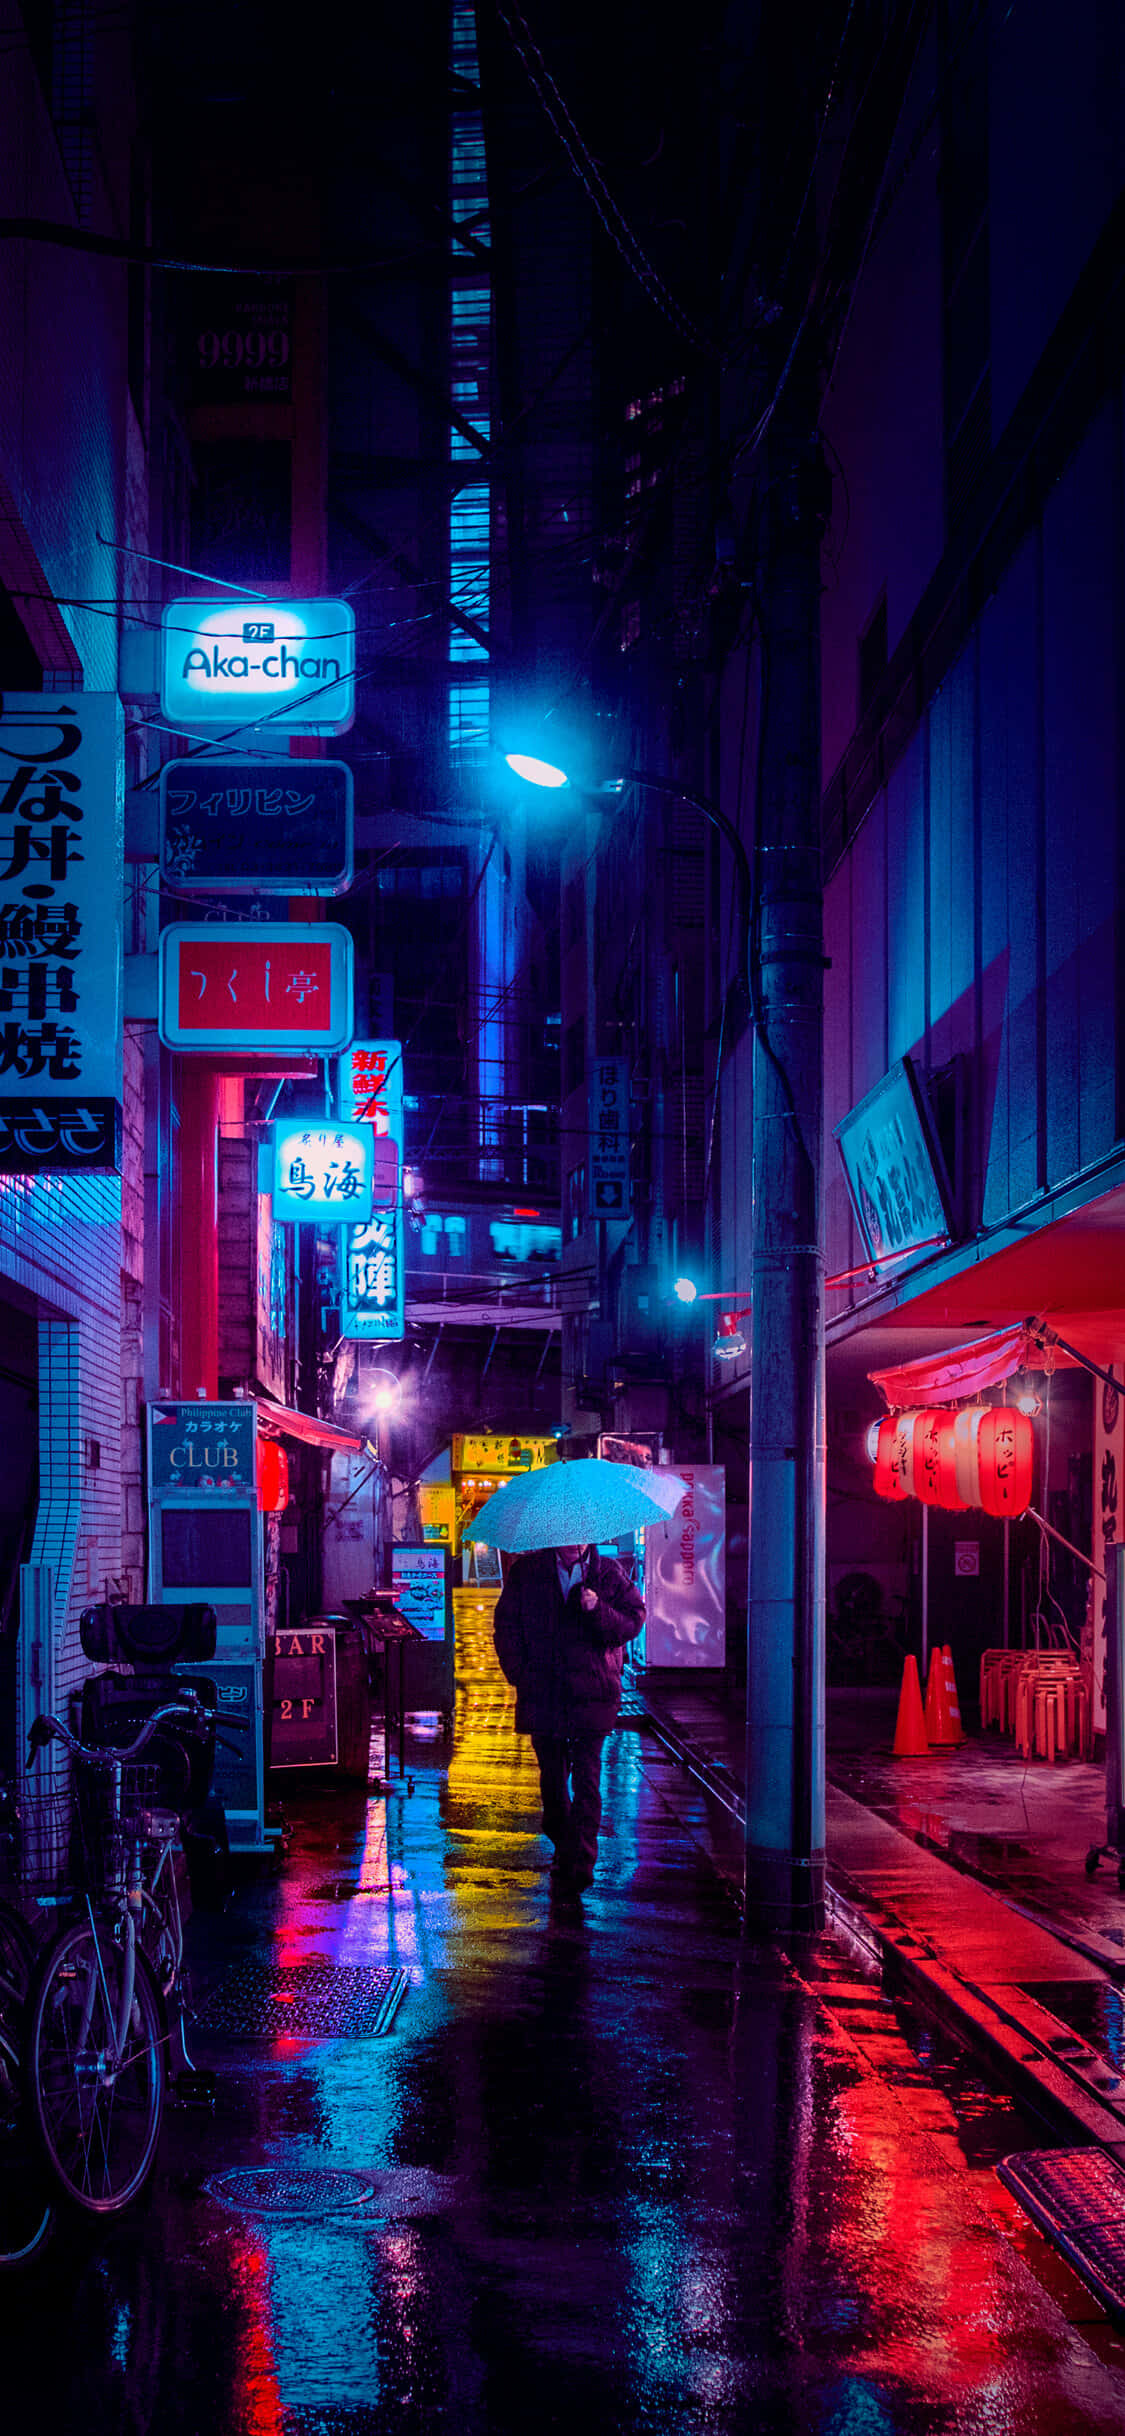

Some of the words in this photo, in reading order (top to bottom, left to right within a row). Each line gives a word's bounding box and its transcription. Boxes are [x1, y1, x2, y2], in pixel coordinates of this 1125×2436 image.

[198, 328, 289, 369] 9999
[248, 625, 271, 641] 2F
[182, 646, 341, 679] Aka-chan
[167, 787, 317, 817] フィリピン
[185, 1420, 242, 1433] カラオケ
[169, 1444, 239, 1468] CLUB
[995, 1429, 1015, 1499] ホッピー
[280, 1698, 315, 1720] 2F
